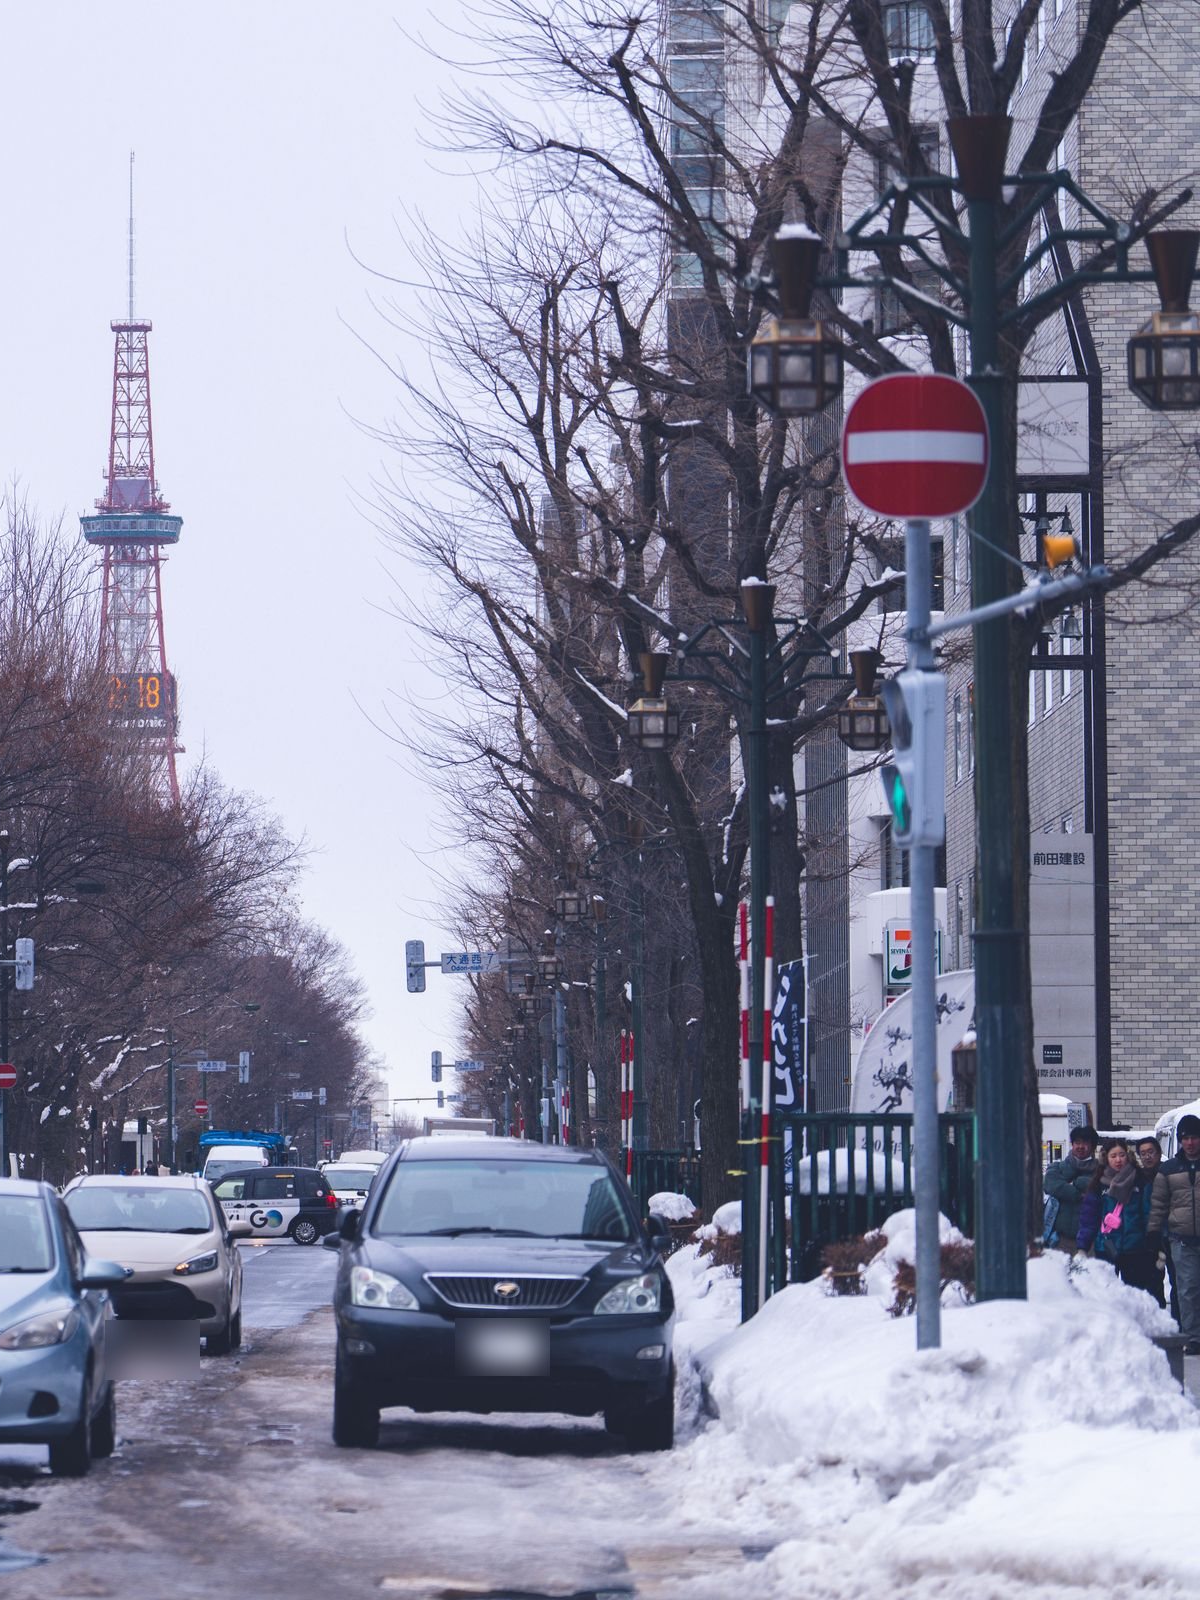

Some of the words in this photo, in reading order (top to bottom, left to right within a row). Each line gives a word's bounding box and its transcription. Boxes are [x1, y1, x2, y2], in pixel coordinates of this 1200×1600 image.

[1033, 852, 1085, 865] 前田建設
[446, 953, 482, 965] 大通西
[487, 953, 496, 964] 7
[1035, 1068, 1092, 1078] 際会計事務所
